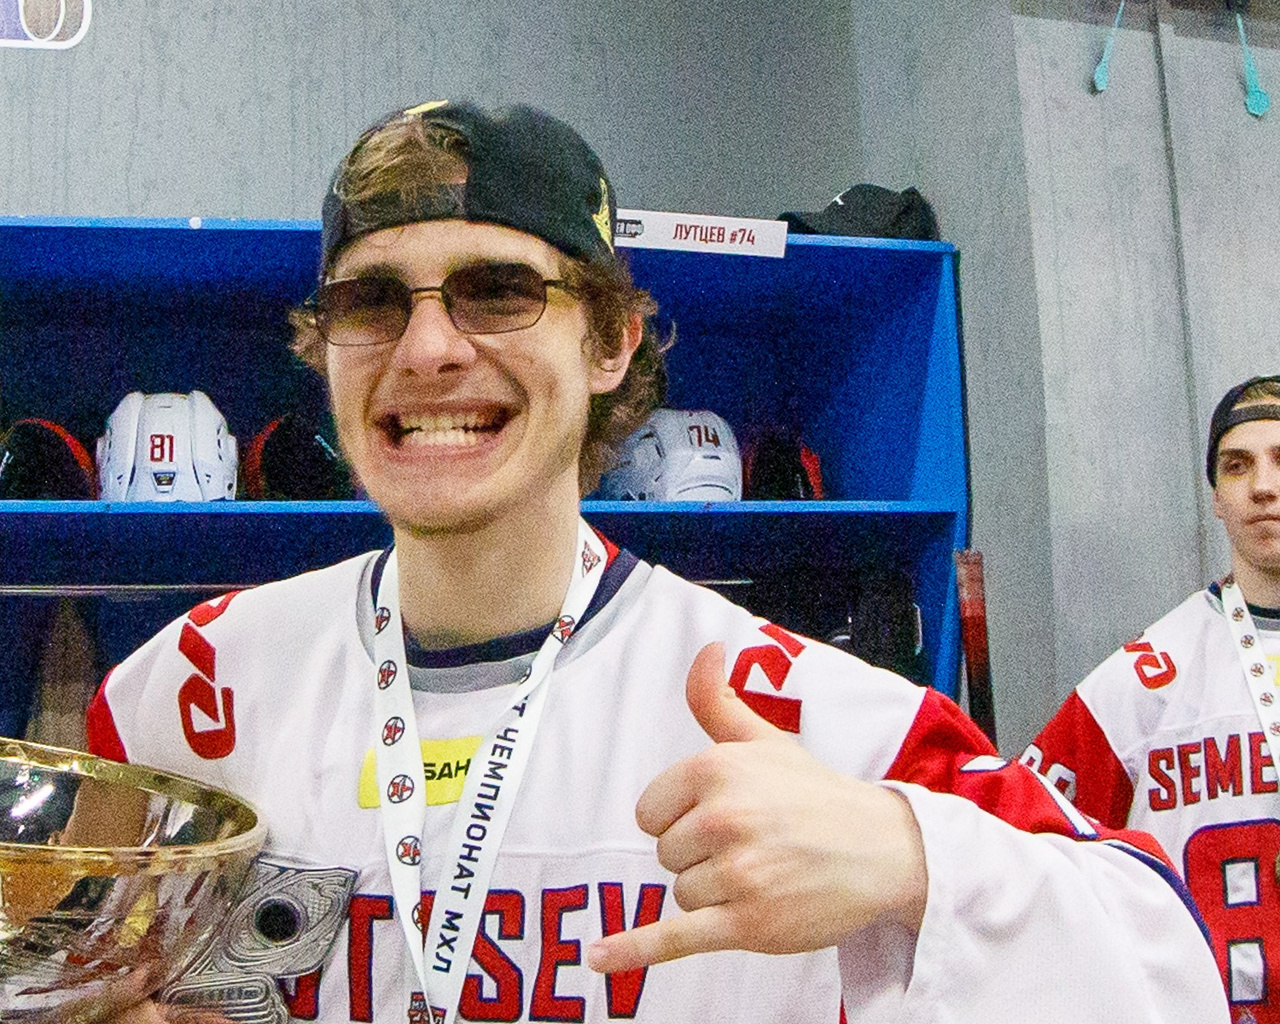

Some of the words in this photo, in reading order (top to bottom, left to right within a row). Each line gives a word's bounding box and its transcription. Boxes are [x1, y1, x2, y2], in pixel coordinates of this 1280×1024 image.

[673, 222, 726, 244] ЛУТЦЕВ
[729, 228, 756, 246] #74
[149, 433, 176, 463] 81
[688, 424, 721, 449] 74
[423, 757, 472, 781] БАН
[450, 726, 519, 900] ЧЕМПИОНАТ
[432, 908, 464, 974] МХЛ
